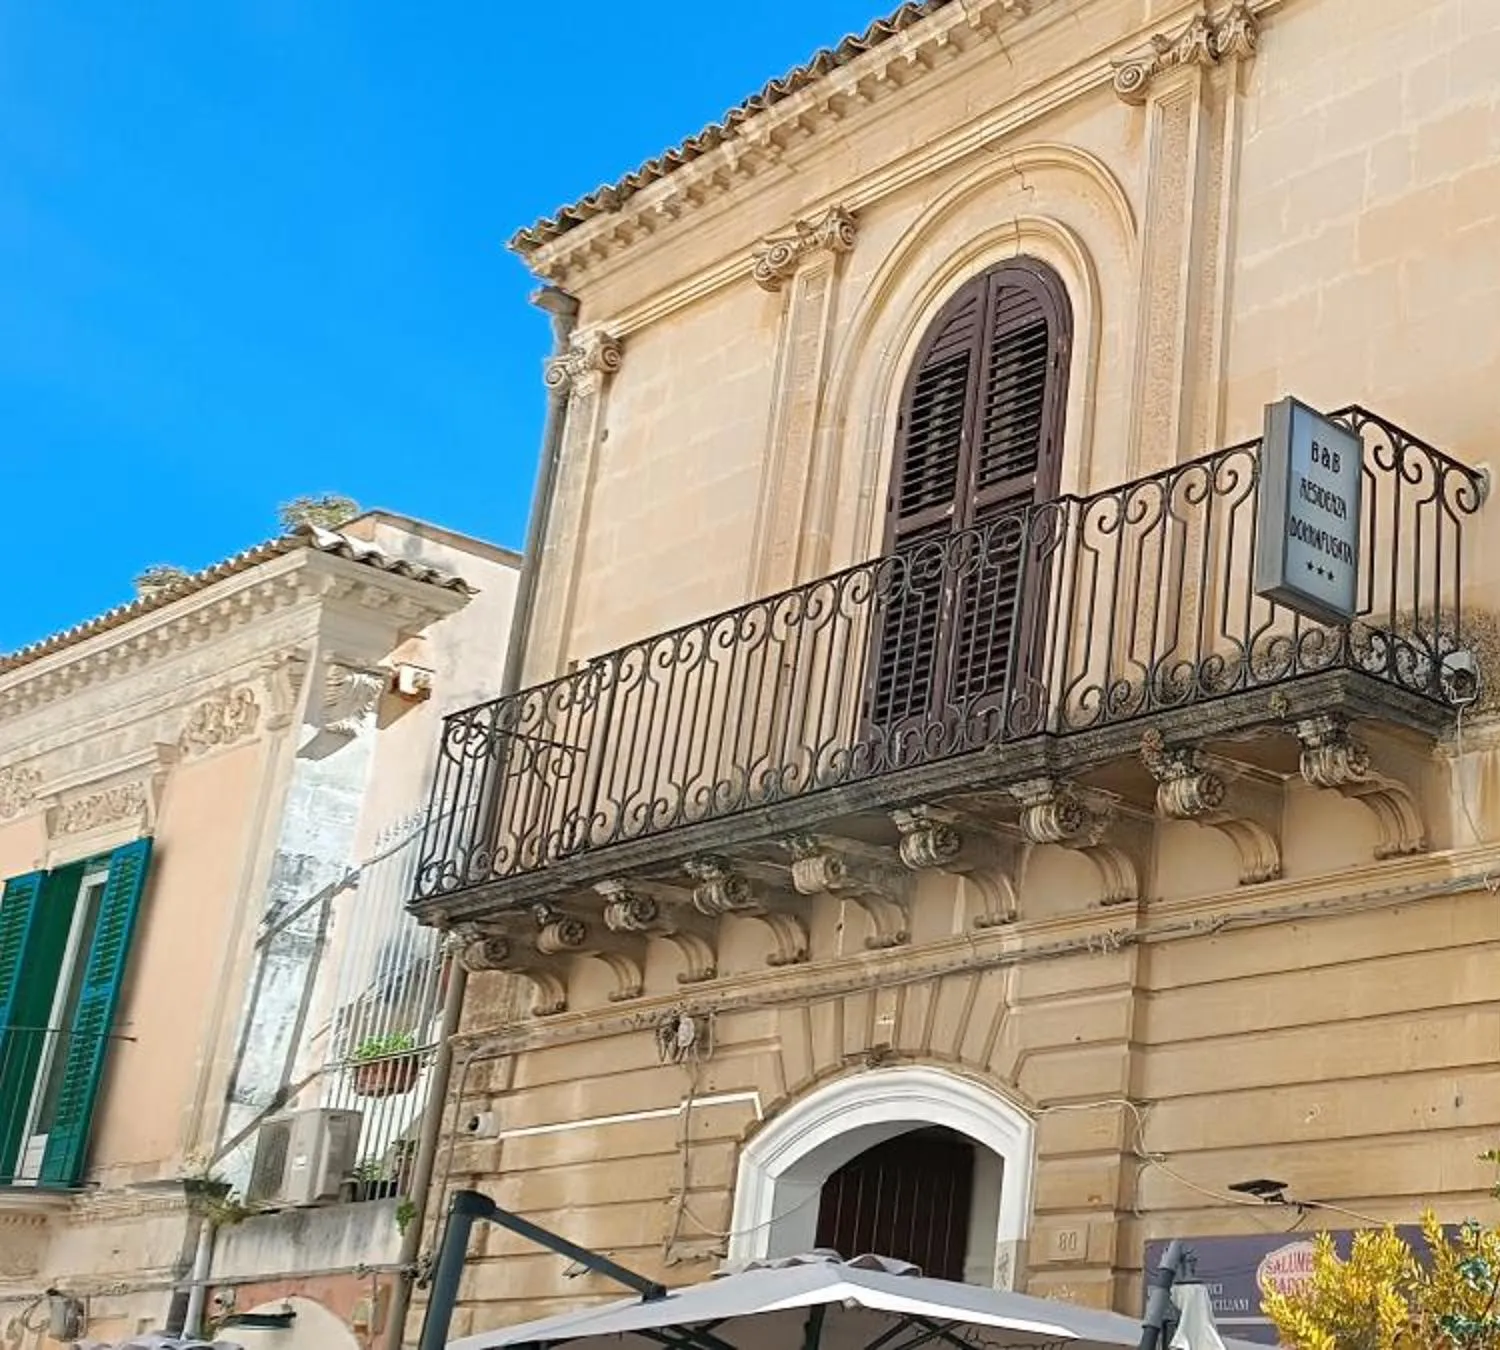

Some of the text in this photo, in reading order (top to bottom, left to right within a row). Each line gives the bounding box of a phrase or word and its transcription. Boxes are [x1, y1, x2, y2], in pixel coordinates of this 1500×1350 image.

[1311, 441, 1341, 473] B&B
[1300, 477, 1347, 521] RESIDENZA
[1059, 1231, 1077, 1251] 80
